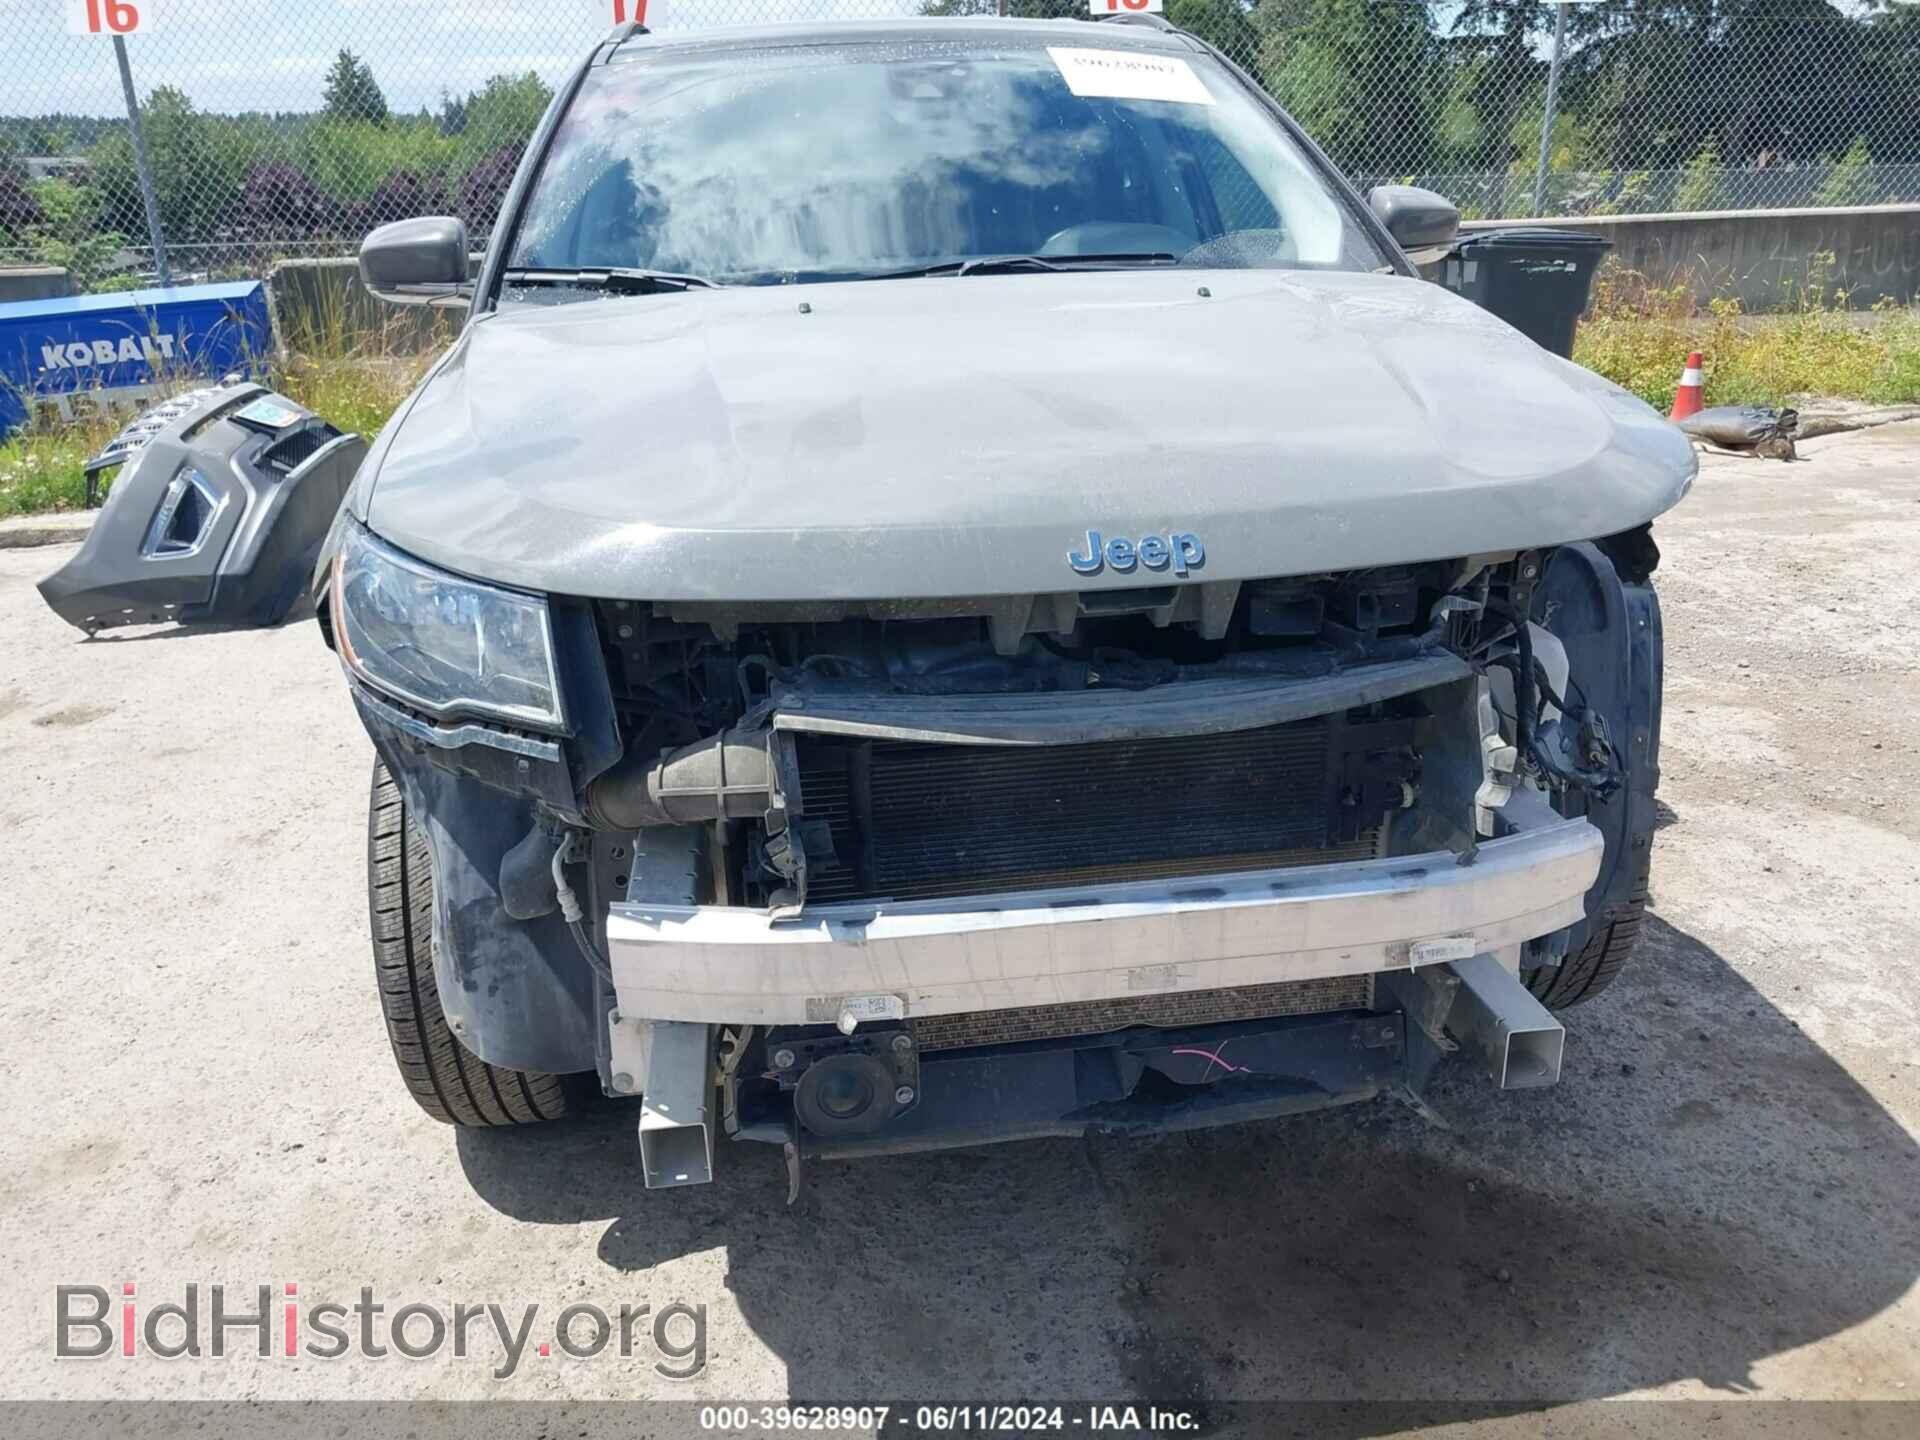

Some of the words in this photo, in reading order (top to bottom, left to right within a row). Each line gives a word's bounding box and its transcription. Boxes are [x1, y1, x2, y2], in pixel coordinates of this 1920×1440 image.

[85, 0, 139, 33] 16
[40, 334, 175, 369] KOBALT
[1067, 529, 1205, 577] Jeep
